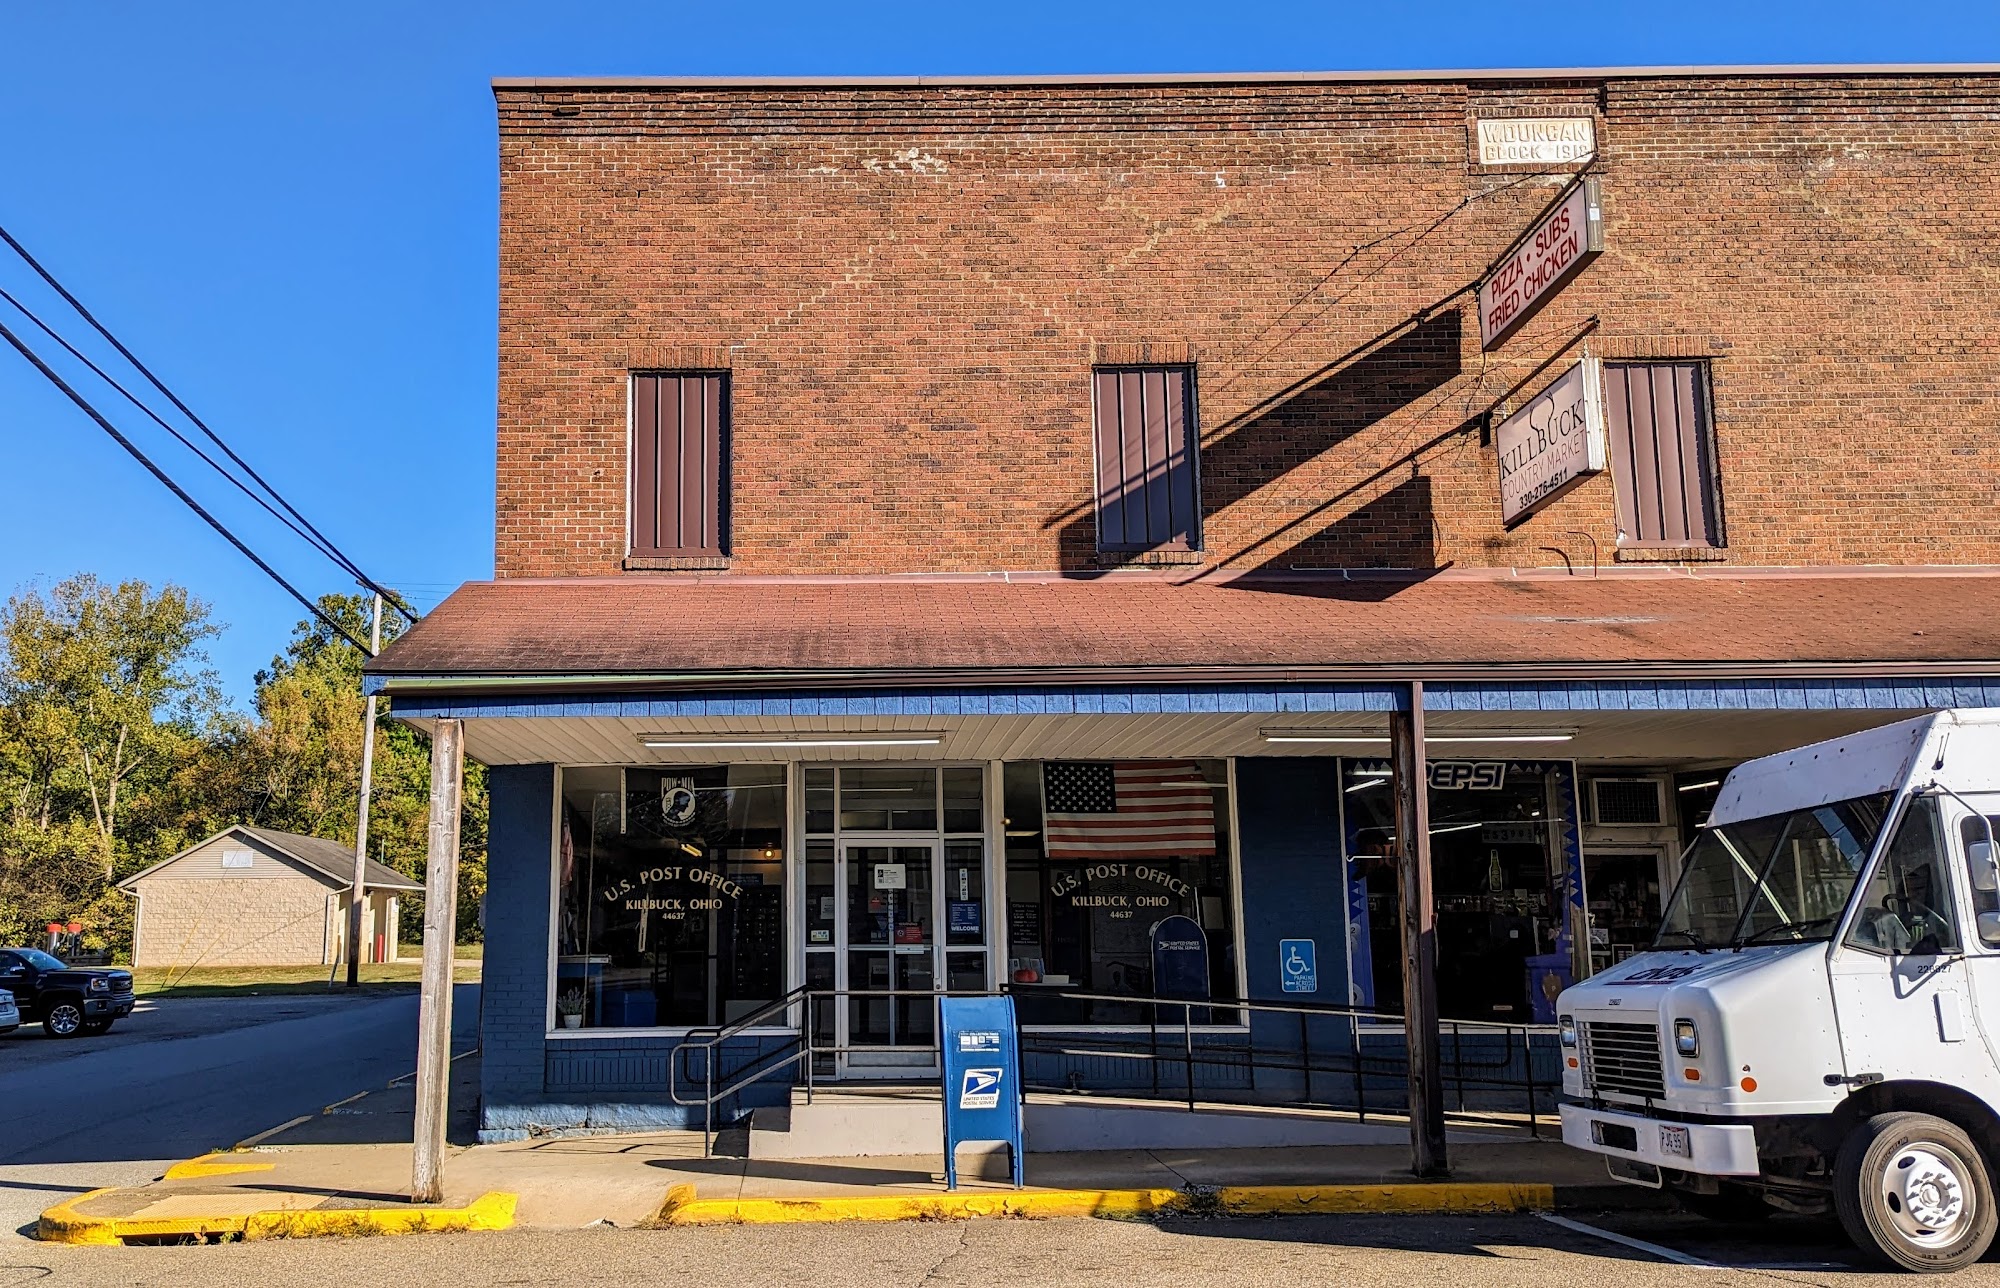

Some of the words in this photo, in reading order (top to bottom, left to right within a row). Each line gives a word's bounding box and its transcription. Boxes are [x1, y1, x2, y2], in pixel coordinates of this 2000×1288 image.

[1485, 145, 1543, 160] BLOCK
[1491, 255, 1524, 303] PIZZA
[1536, 207, 1570, 257] SUBS
[1488, 289, 1520, 336] FRIED
[1523, 230, 1578, 301] CHICKEN
[1500, 397, 1585, 480] KILLBUCK
[1501, 456, 1544, 502] COUNTRY
[1547, 429, 1586, 470] MARKET
[1518, 466, 1569, 509] 330-276-4511
[661, 777, 678, 799] POW
[681, 776, 695, 797] MIA
[604, 879, 635, 901] U.S.
[640, 866, 683, 885] POST
[689, 868, 744, 899] OFFICE
[1050, 875, 1082, 897] U.S.
[1085, 863, 1129, 882] POST
[1135, 865, 1191, 897] OFFICE
[625, 898, 685, 911] KILLBUCK,
[690, 898, 723, 910] OHIO
[662, 912, 686, 920] 44637
[1071, 895, 1132, 908] KILLBUCK,
[1135, 895, 1170, 907] OHIO
[1109, 911, 1134, 919] 44637
